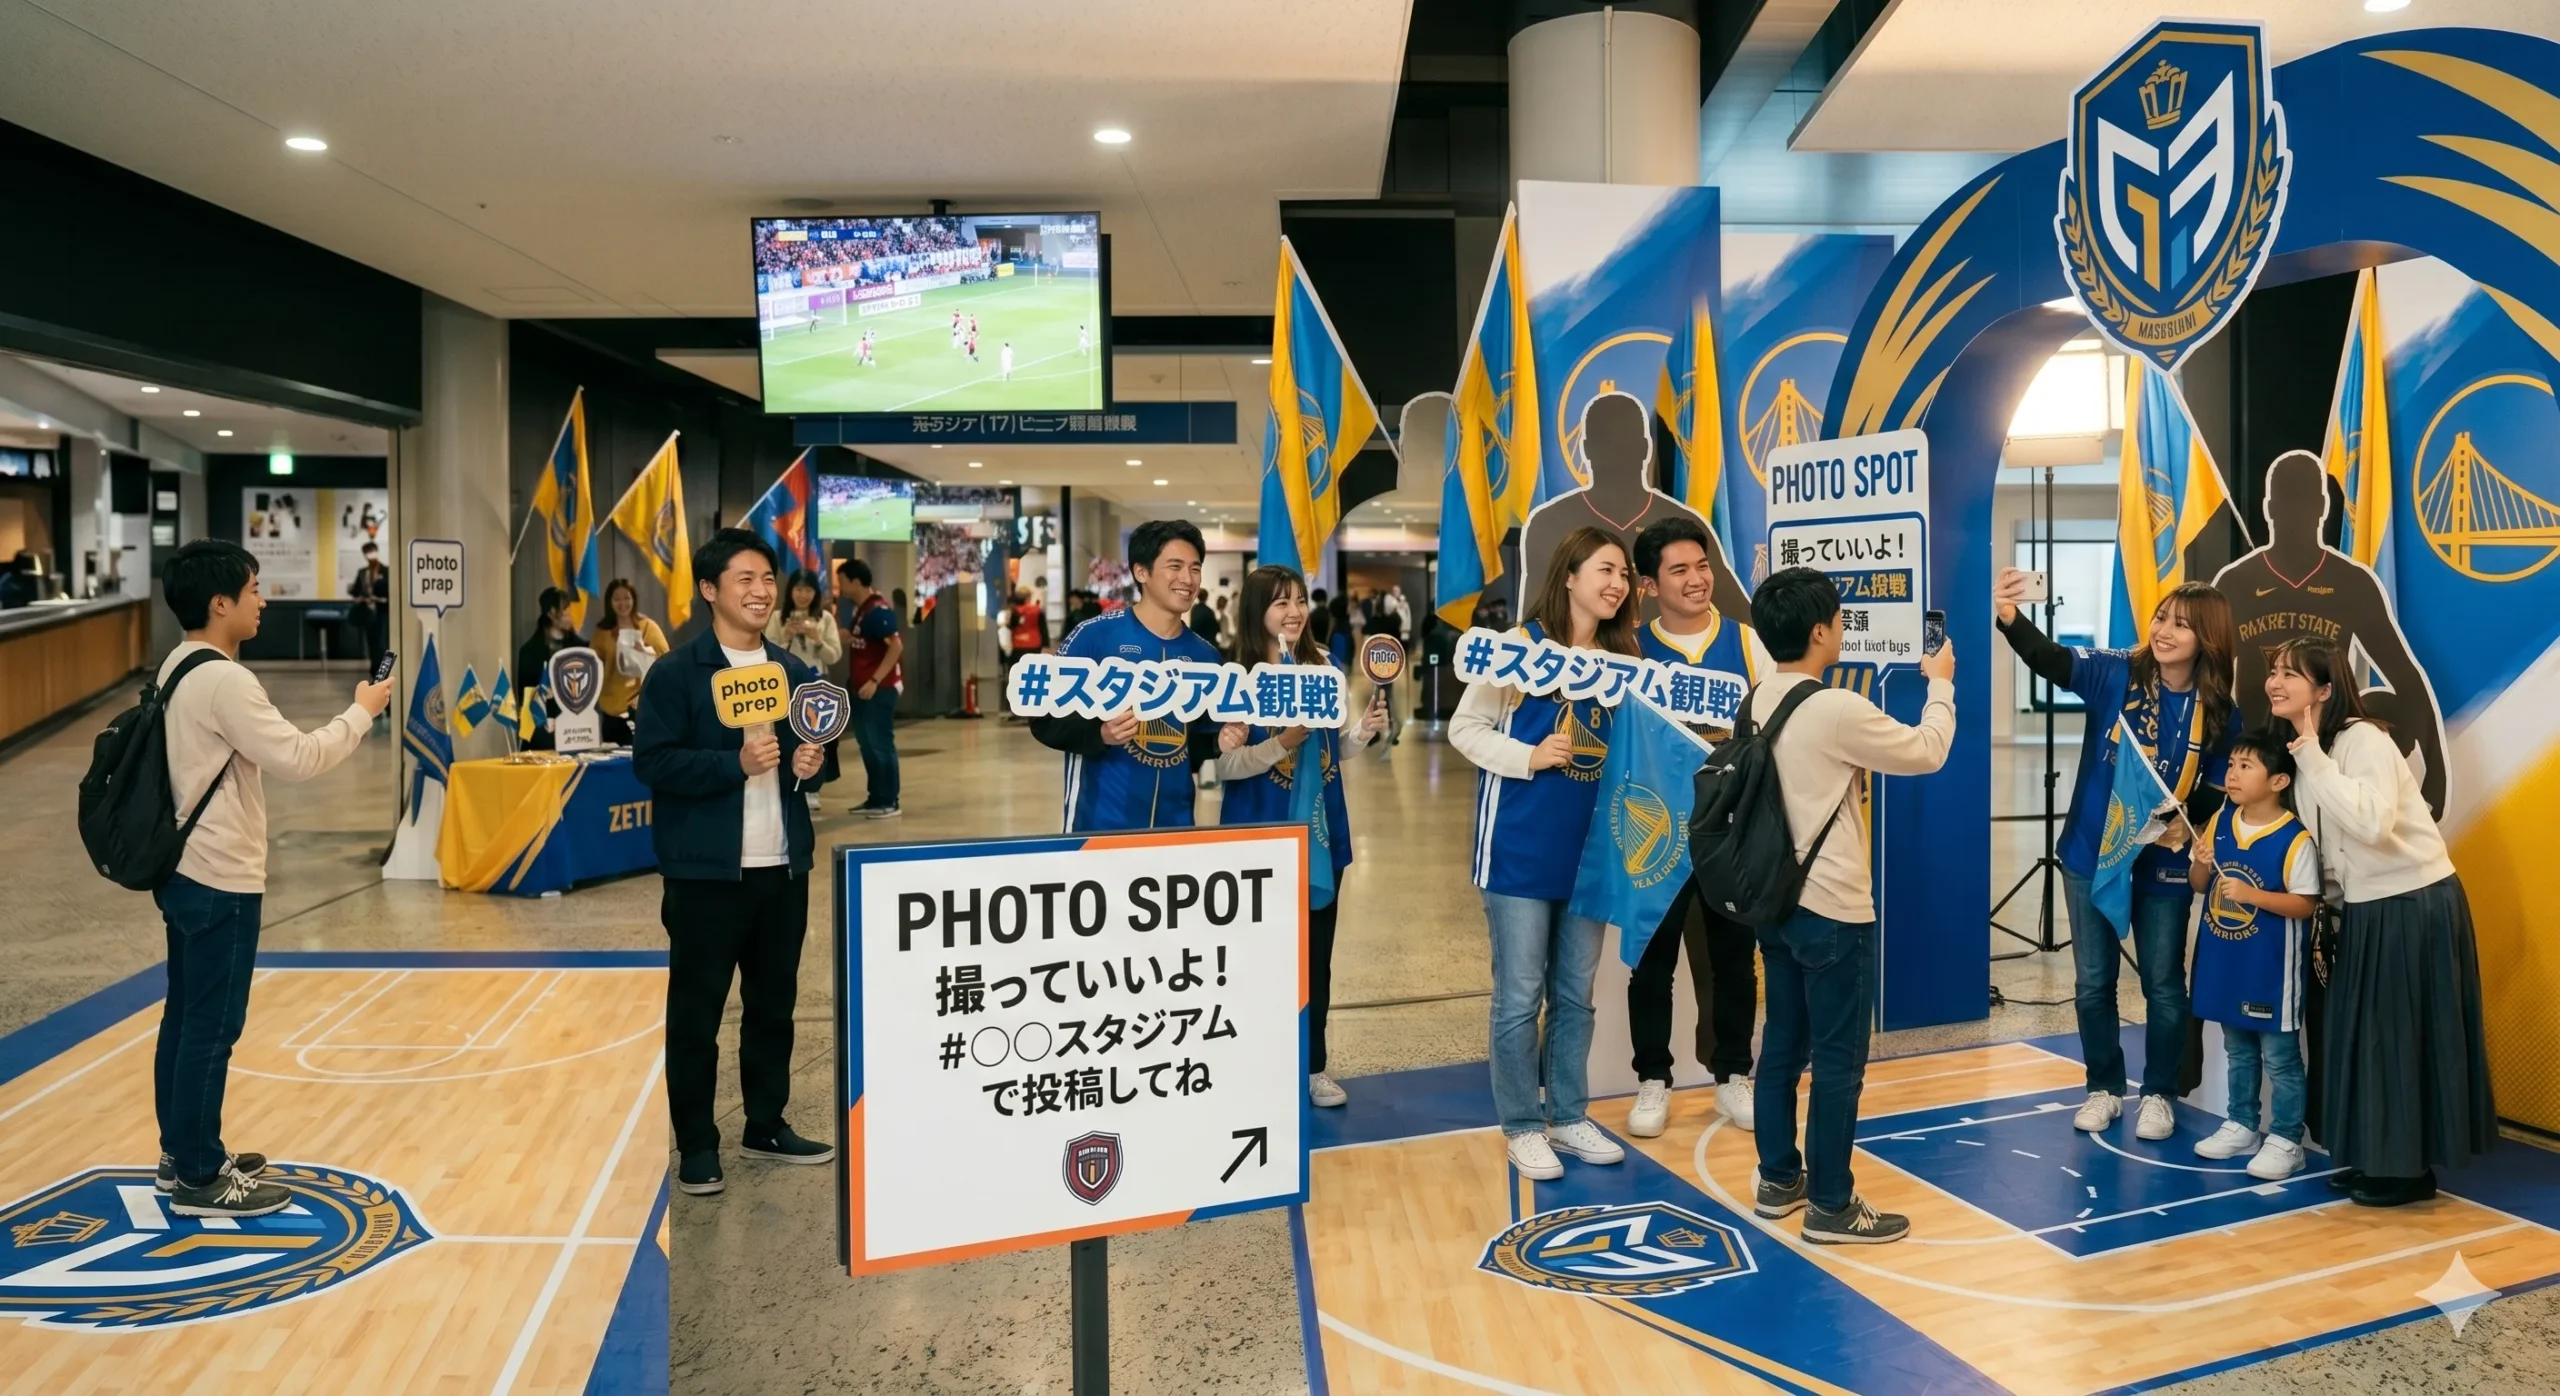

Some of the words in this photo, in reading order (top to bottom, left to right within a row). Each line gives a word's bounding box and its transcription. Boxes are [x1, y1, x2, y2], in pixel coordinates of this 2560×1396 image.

[1772, 458, 1845, 505] PHOTO
[1854, 449, 1918, 498] SPOT
[416, 553, 458, 572] photo
[421, 576, 454, 594] prap
[2298, 612, 2342, 641] STATE
[721, 677, 779, 700] photo
[1018, 663, 1339, 721] #スタジアム観戦
[732, 696, 778, 718] prep
[898, 879, 1108, 952] PHOTO
[1127, 868, 1274, 933] SPOT
[982, 1057, 1213, 1117] で投稿してね
